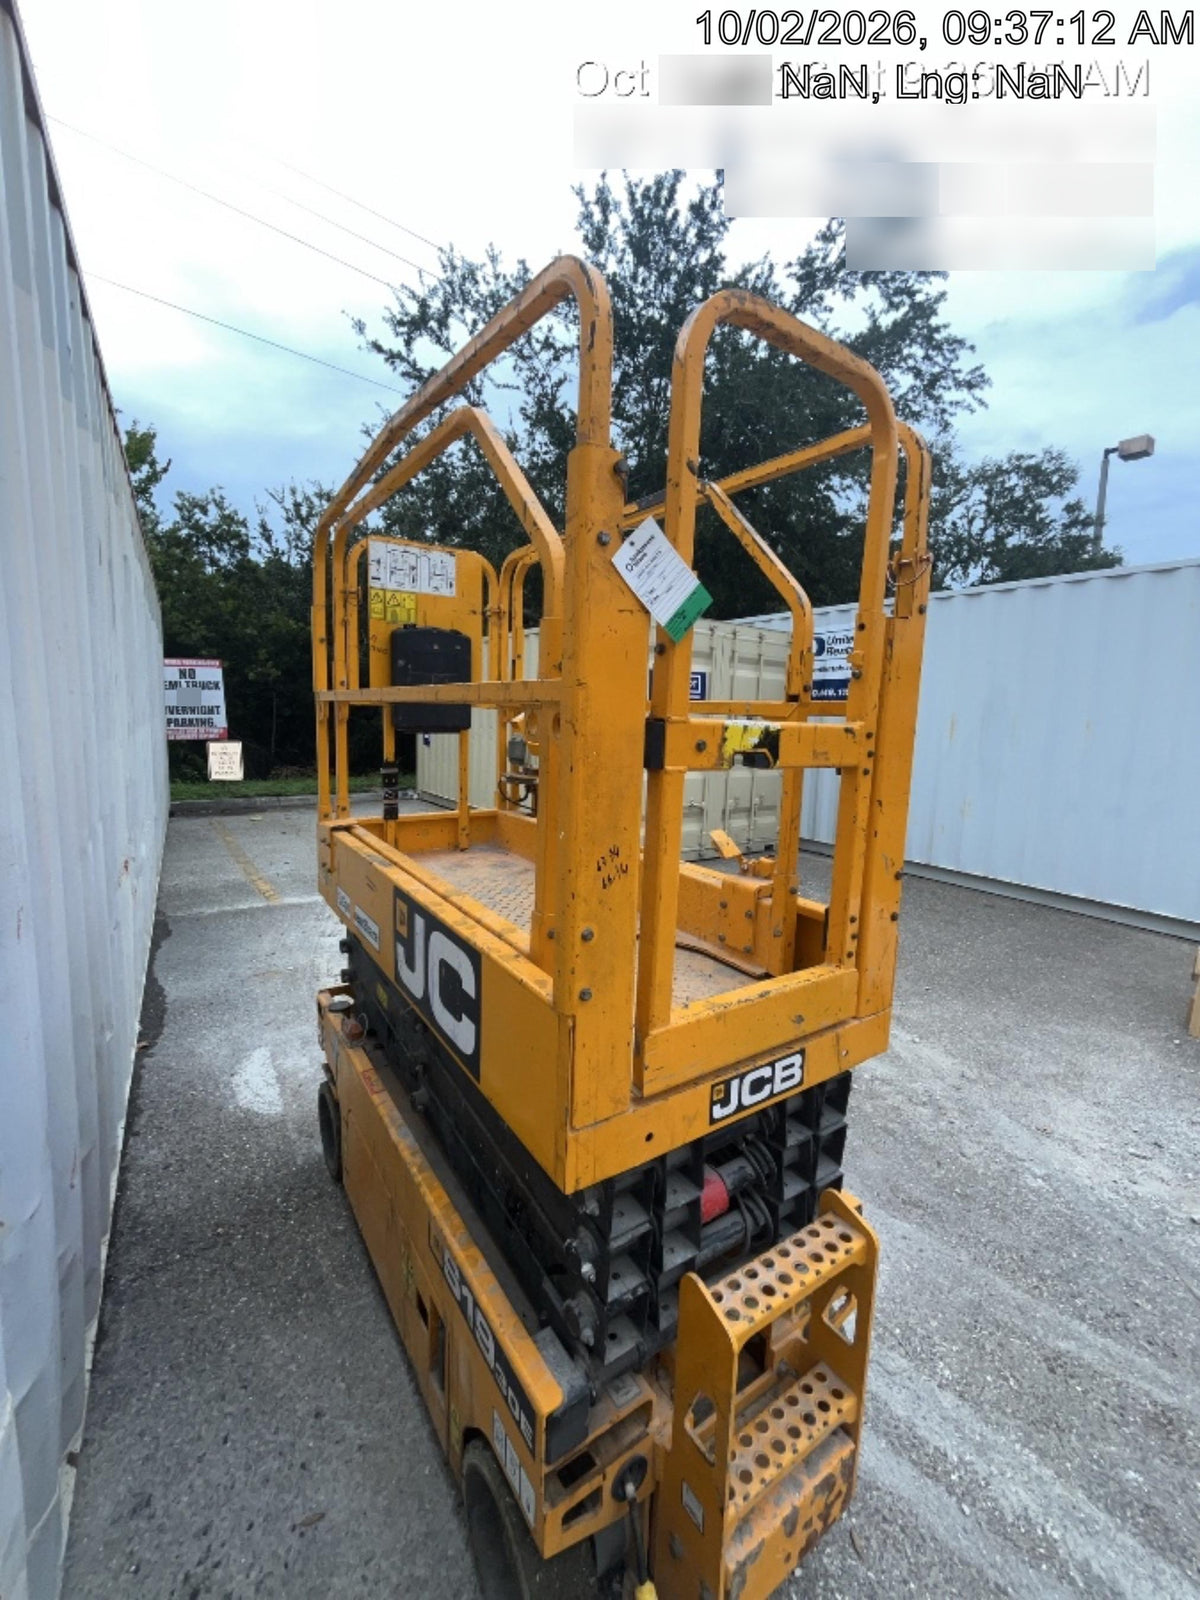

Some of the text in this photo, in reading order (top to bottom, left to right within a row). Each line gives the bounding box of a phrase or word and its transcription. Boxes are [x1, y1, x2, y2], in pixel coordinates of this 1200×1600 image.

[178, 668, 196, 680] NO
[184, 680, 221, 691] TRUCK
[165, 705, 221, 716] VERNIGHT
[712, 1053, 803, 1119] JCB
